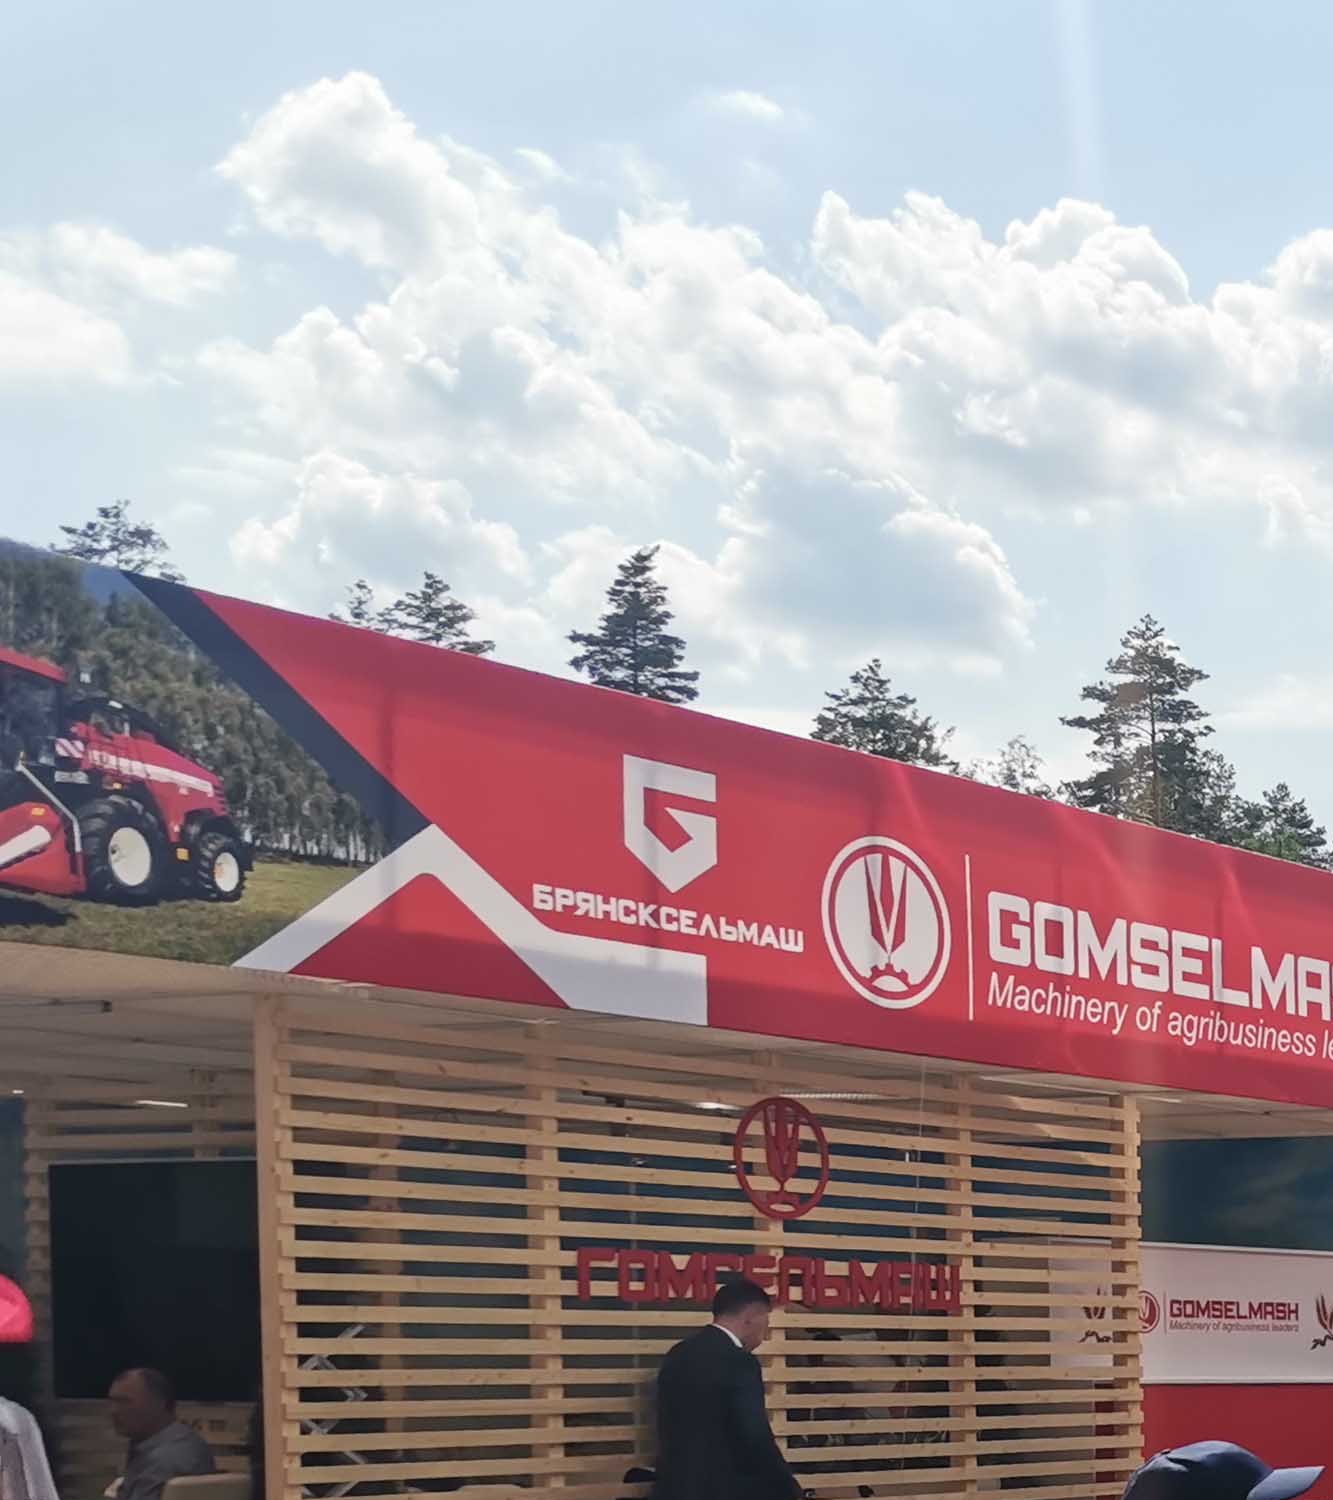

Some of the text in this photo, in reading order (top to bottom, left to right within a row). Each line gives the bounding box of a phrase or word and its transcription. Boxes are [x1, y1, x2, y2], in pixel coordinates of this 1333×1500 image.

[532, 884, 804, 953] БРЯНСКСЕЛЬМАШ
[988, 972, 1129, 1035] Machinery
[1135, 1001, 1163, 1033] of
[1168, 1010, 1317, 1057] agribusiness
[1169, 1299, 1299, 1321] GOMSELMASH
